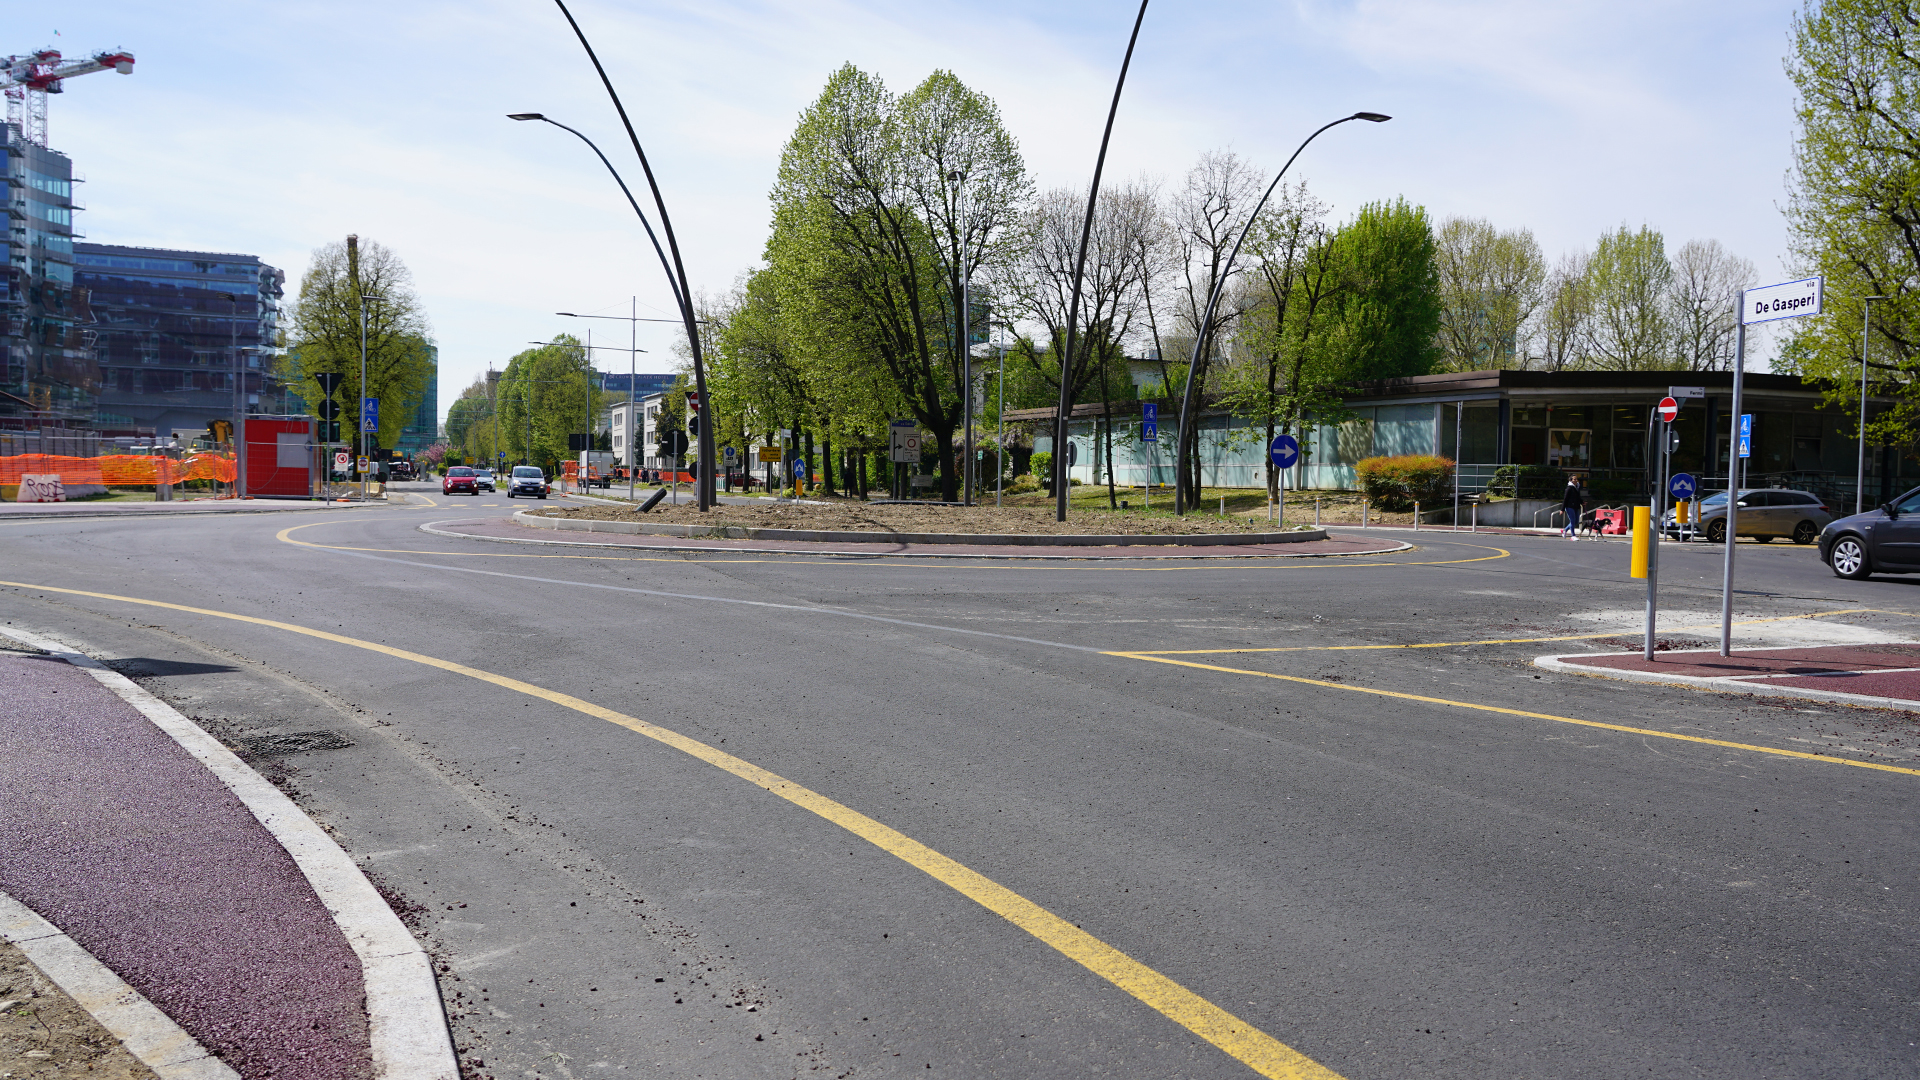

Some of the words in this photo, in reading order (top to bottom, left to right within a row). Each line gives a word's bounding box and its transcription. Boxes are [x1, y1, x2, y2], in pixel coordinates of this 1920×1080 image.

[1806, 280, 1815, 288] via
[1755, 301, 1770, 314] De
[1772, 292, 1815, 312] Gasperi
